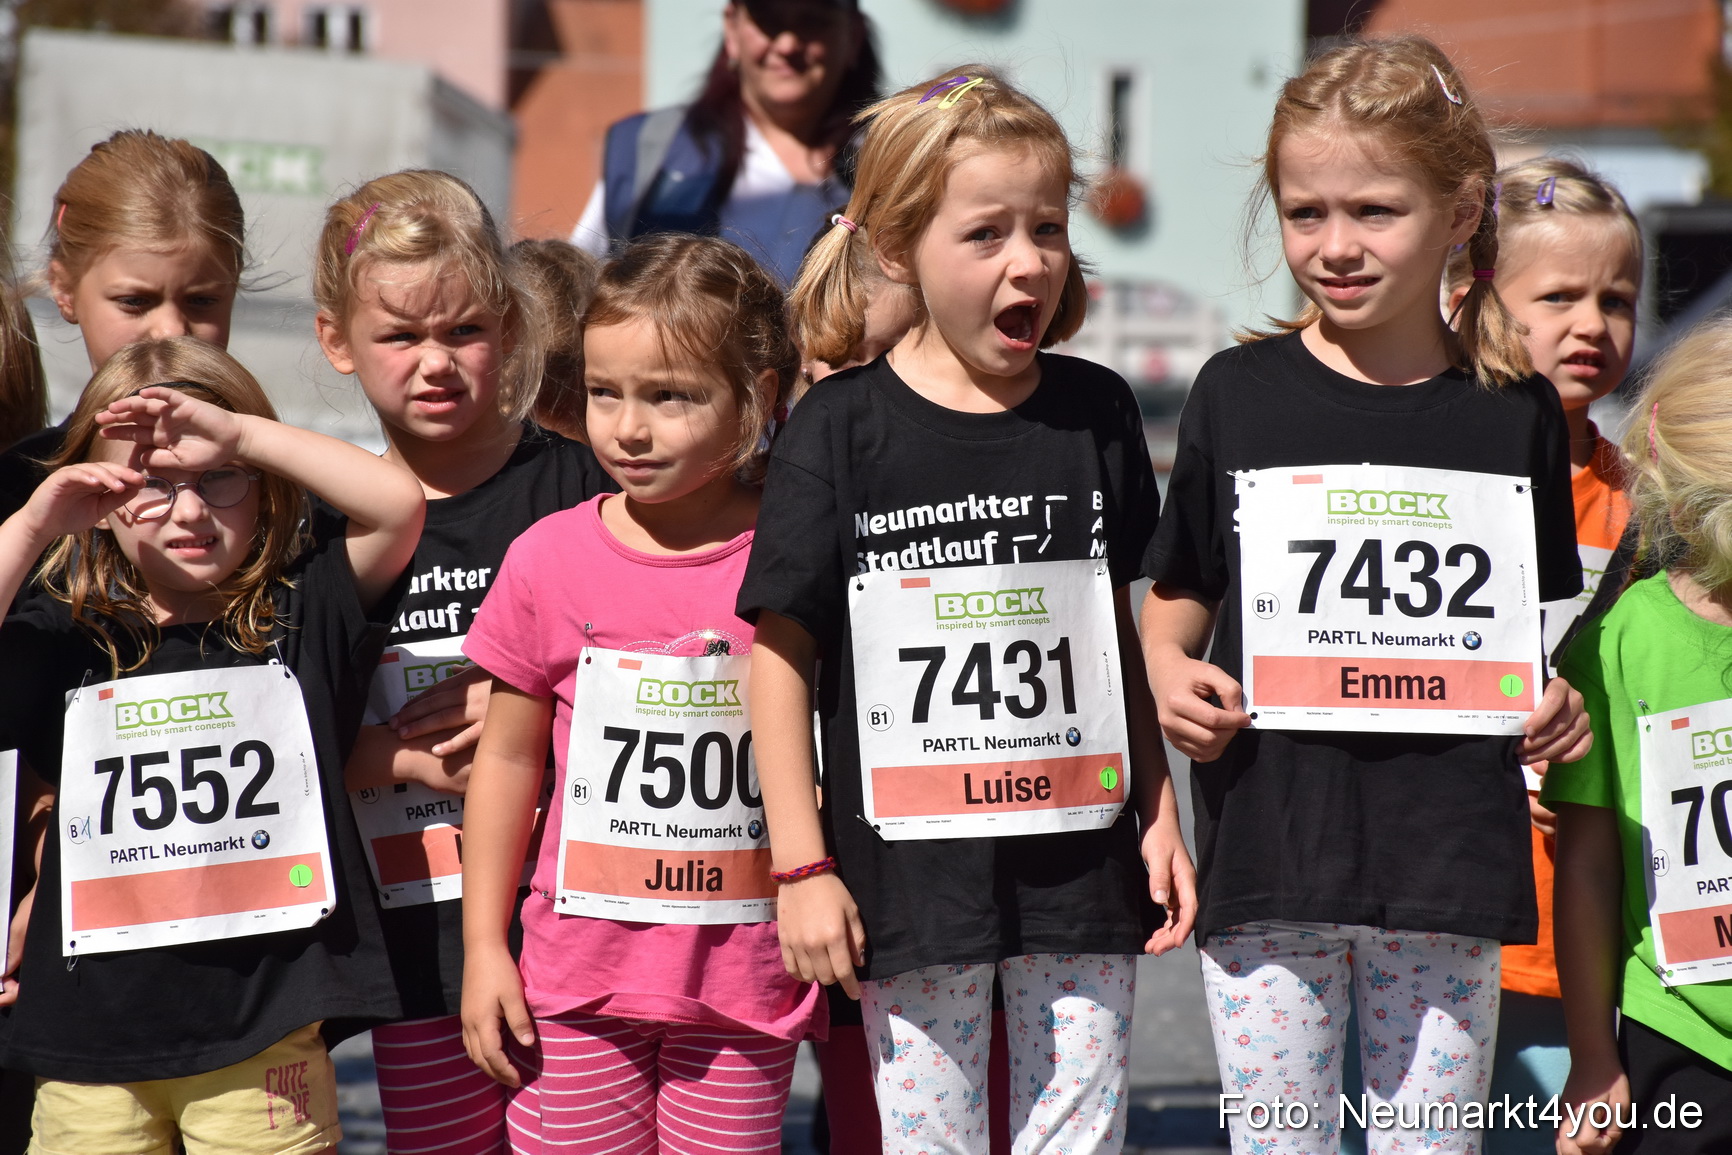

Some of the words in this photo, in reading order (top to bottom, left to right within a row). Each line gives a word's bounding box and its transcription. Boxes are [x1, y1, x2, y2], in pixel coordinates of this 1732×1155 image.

[855, 493, 1033, 538] Neumarkter
[1327, 489, 1451, 519] BOCK
[1327, 516, 1365, 528] inspired
[1367, 516, 1380, 528] by
[1381, 517, 1409, 527] smart
[1411, 519, 1453, 530] concepts
[856, 531, 999, 573] Stadtlauf
[409, 565, 491, 594] arkter
[1288, 539, 1495, 619] 7432
[934, 587, 1048, 620] BOCK
[1256, 599, 1274, 614] B1
[936, 620, 975, 631] inspired
[977, 620, 987, 630] by
[989, 618, 1016, 628] smart
[1017, 615, 1050, 627] concepts
[1307, 630, 1367, 645] PARTL
[1372, 631, 1455, 647] Neumarkt
[636, 678, 741, 707] BOCK
[898, 637, 1077, 723] 7431
[1340, 667, 1446, 701] Emma
[116, 692, 233, 730] BOCK
[635, 706, 667, 718] inspired
[669, 708, 680, 719] by
[682, 709, 708, 718] smart
[710, 708, 744, 718] concepts
[870, 711, 889, 726] B1
[116, 729, 148, 740] inspired
[150, 727, 162, 737] by
[164, 724, 193, 735] smart
[194, 720, 236, 731] concepts
[922, 737, 980, 753] PARTL
[984, 732, 1061, 750] Neumarkt
[1693, 757, 1725, 770] inspired
[94, 740, 280, 835] 7552
[574, 784, 587, 799] B1
[963, 770, 1051, 805] Luise
[405, 800, 457, 820] PARTL
[610, 818, 662, 837] PARTL
[666, 824, 742, 838] Neumarkt
[110, 845, 160, 864] PARTL
[164, 836, 245, 858] Neumarkt
[1653, 856, 1665, 870] B1
[645, 859, 723, 892] Julia
[265, 1060, 308, 1098] CUTE
[267, 1091, 311, 1130] LVE
